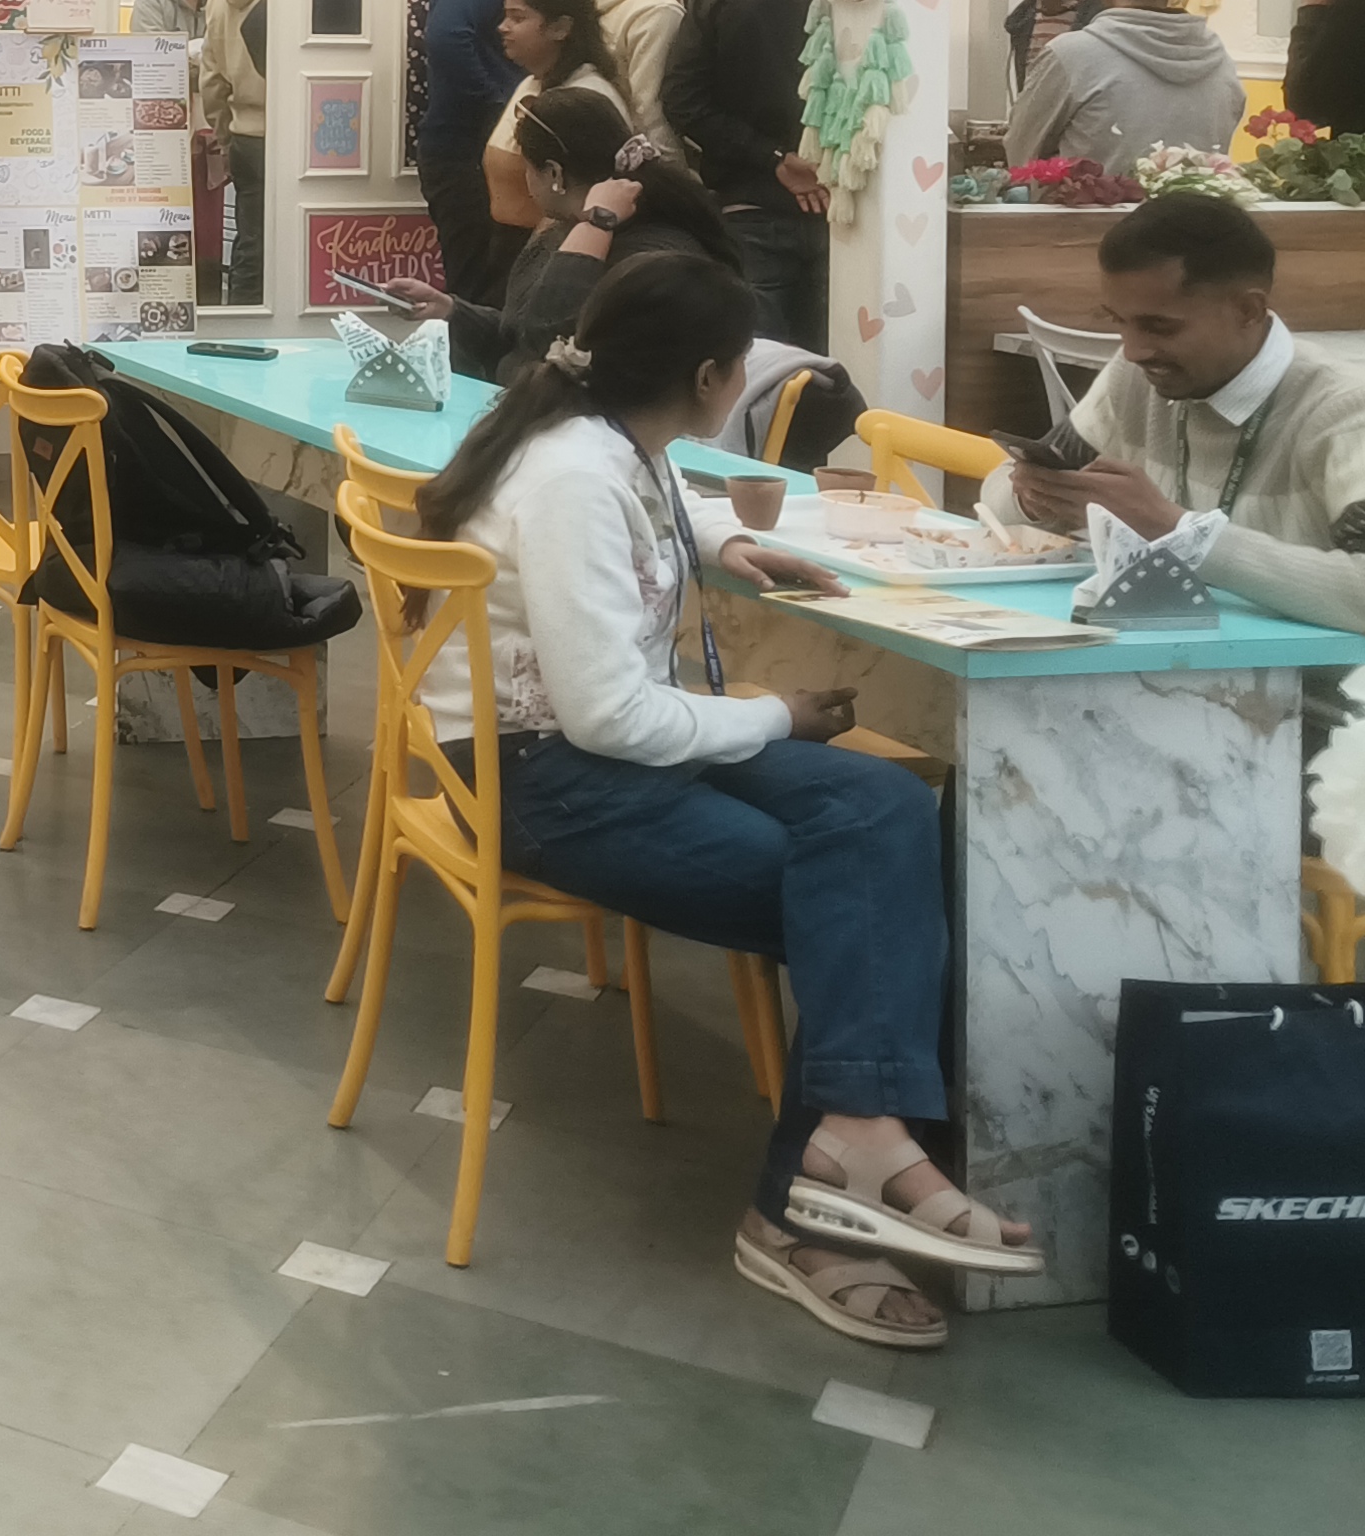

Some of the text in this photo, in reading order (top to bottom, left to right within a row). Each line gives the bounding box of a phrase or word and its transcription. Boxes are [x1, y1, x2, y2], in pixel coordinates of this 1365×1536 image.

[79, 37, 186, 54] MITTI Menu
[21, 128, 45, 137] FOOD
[10, 138, 51, 146] BEVERAGE
[45, 209, 77, 226] Menu
[84, 208, 191, 226] MITTI Menu
[317, 216, 439, 268] Kindness
[1215, 1195, 1365, 1221] SKECH
